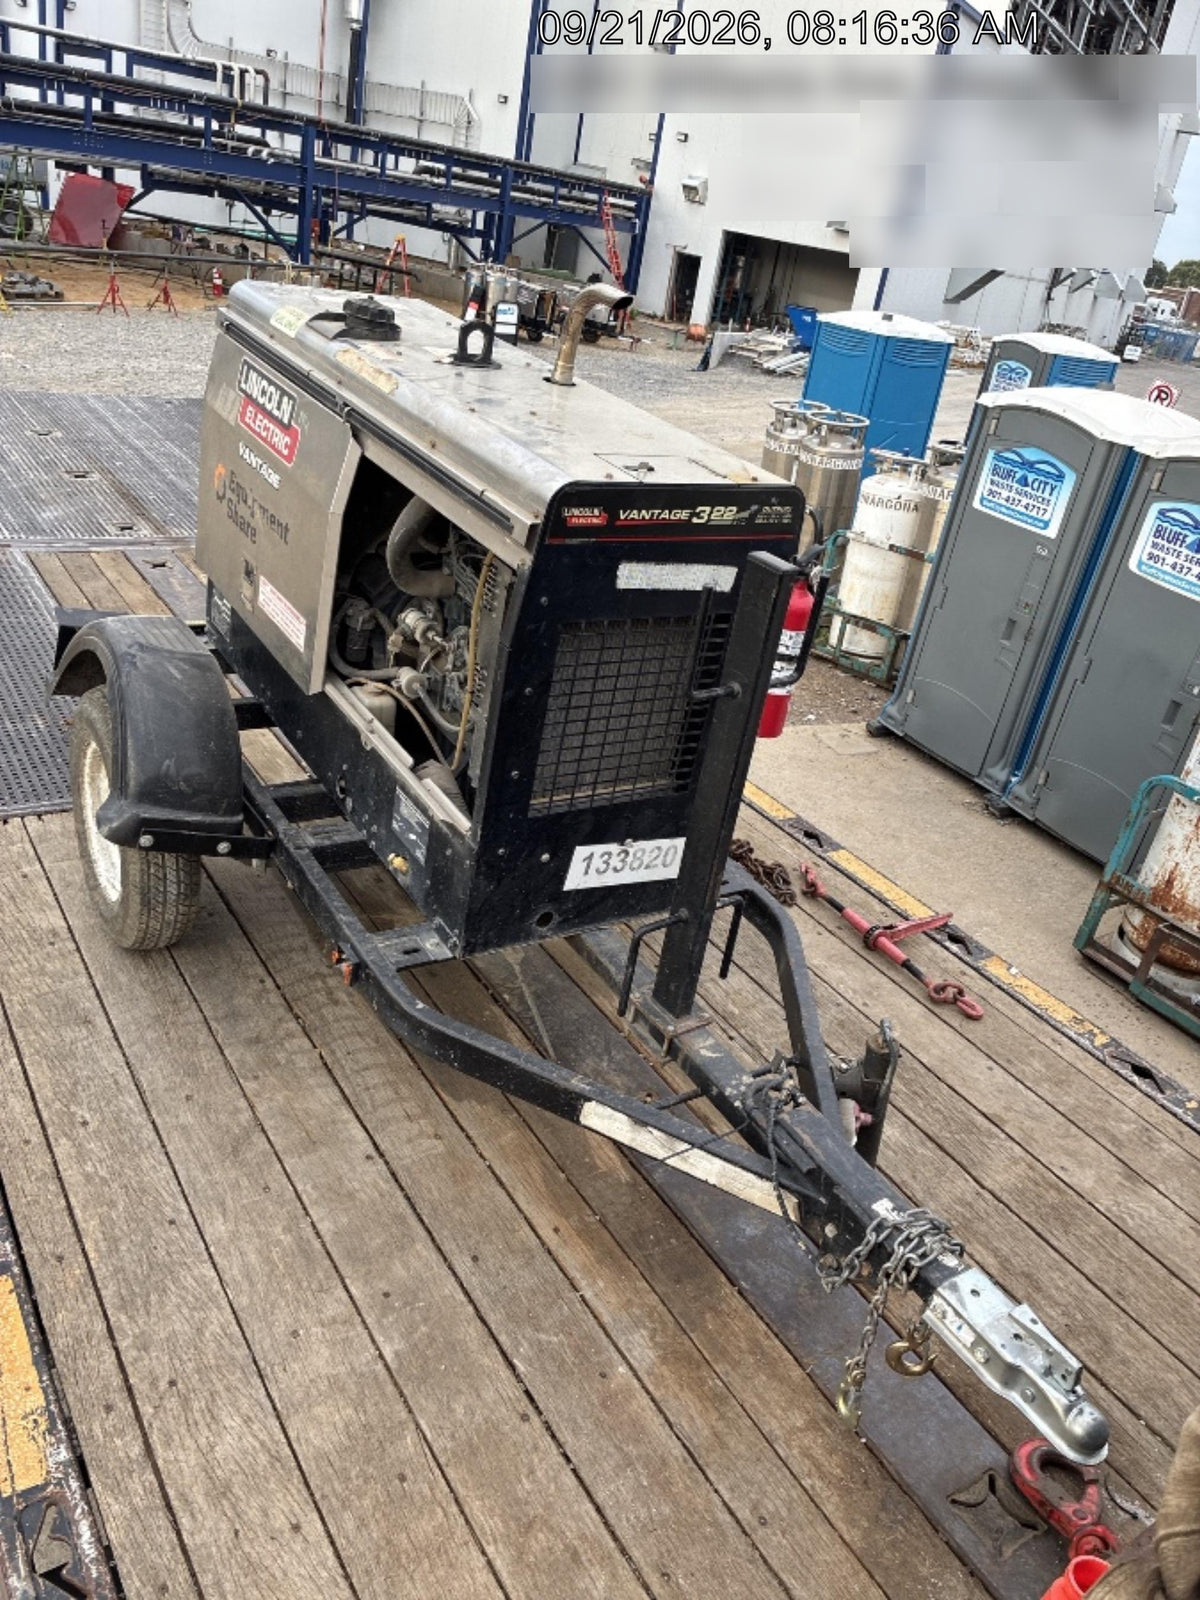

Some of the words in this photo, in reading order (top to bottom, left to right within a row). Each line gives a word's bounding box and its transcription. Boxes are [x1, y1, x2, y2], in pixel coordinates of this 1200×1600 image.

[240, 364, 294, 426] LINCOLN
[244, 404, 292, 457] ELECTRIC
[239, 440, 281, 491] VANTAGE
[991, 462, 1019, 482] BLUFF
[1030, 477, 1059, 497] CITY
[989, 478, 1014, 493] WASTE
[1014, 485, 1052, 508] SERVICES
[226, 497, 257, 545] Share
[619, 508, 693, 521] VANTAGE
[691, 506, 738, 524] 322
[1151, 540, 1183, 559] WASTE
[1153, 524, 1189, 549] BLUFF
[582, 844, 678, 876] 133820
